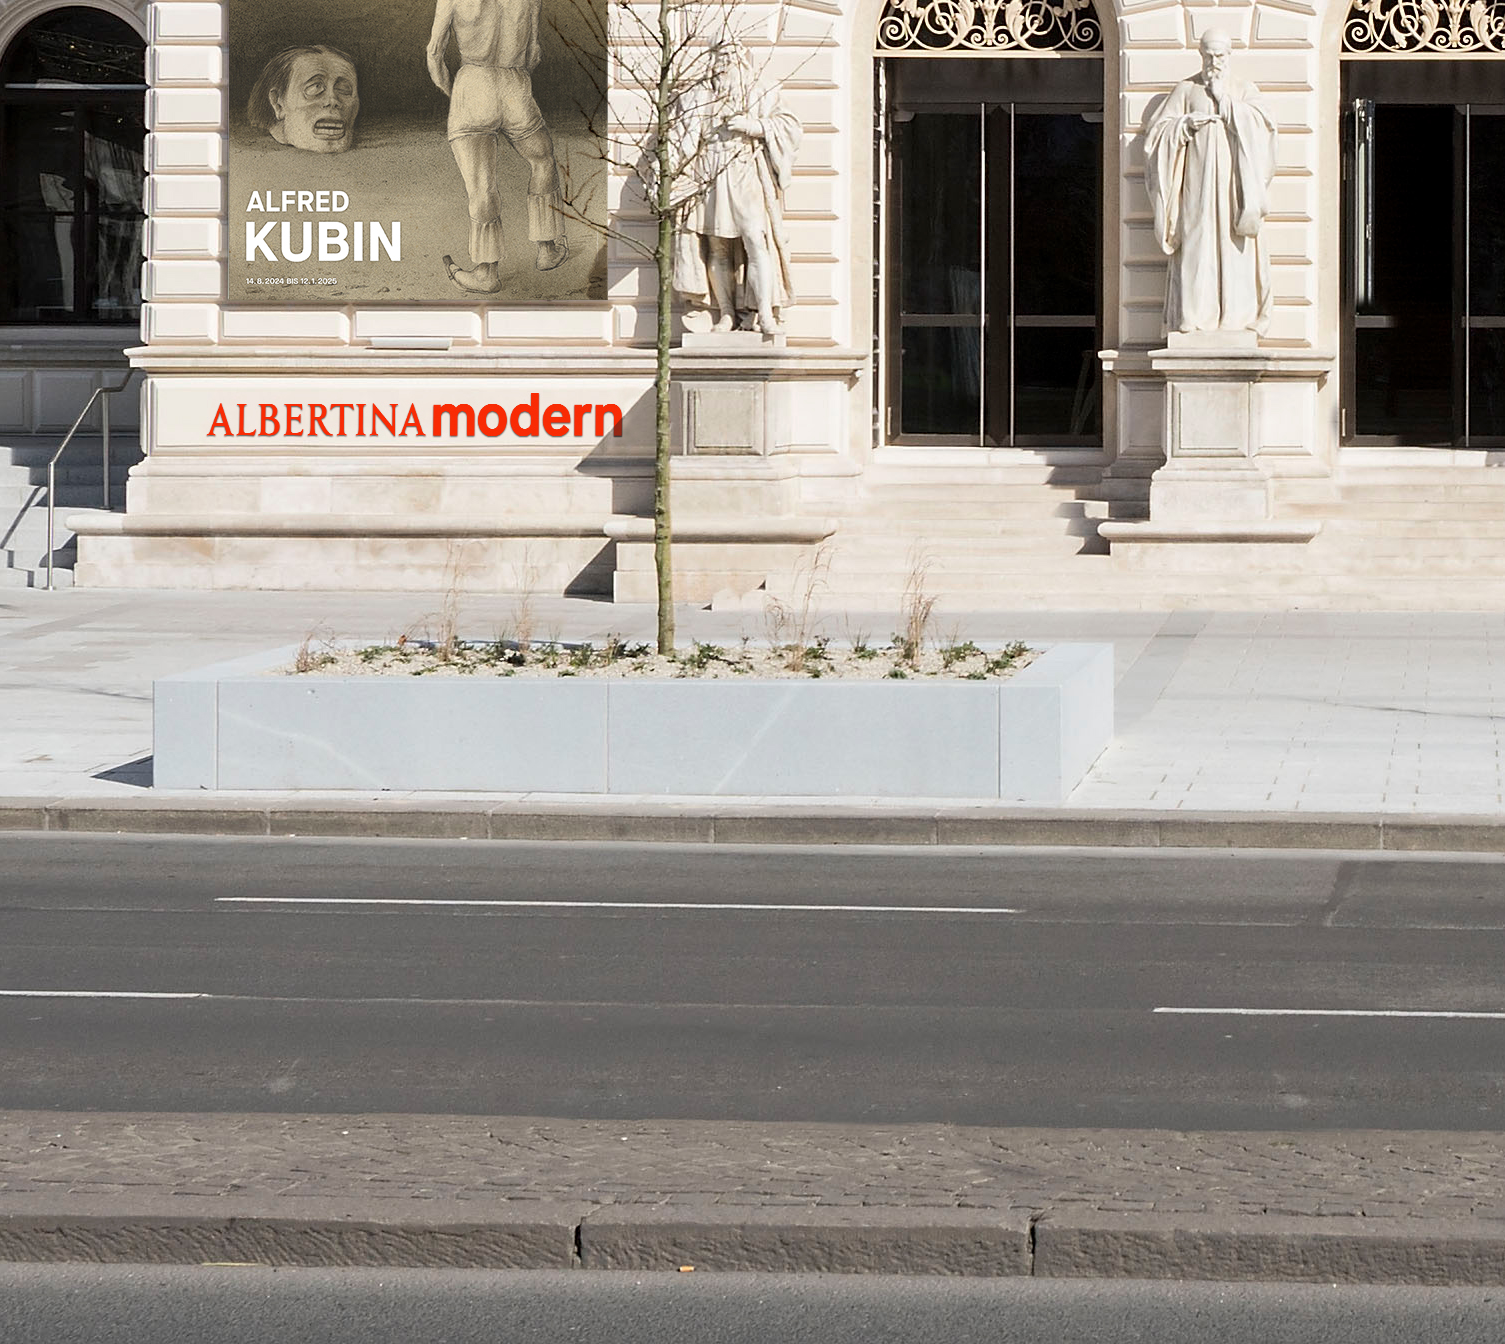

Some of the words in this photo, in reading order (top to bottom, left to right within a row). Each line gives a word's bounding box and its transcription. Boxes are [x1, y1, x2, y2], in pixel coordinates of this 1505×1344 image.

[246, 190, 349, 212] ALFRED
[246, 221, 401, 262] KUBIN
[286, 277, 299, 285] BIS
[206, 402, 427, 437] ALBERTINA
[432, 393, 623, 437] modern
